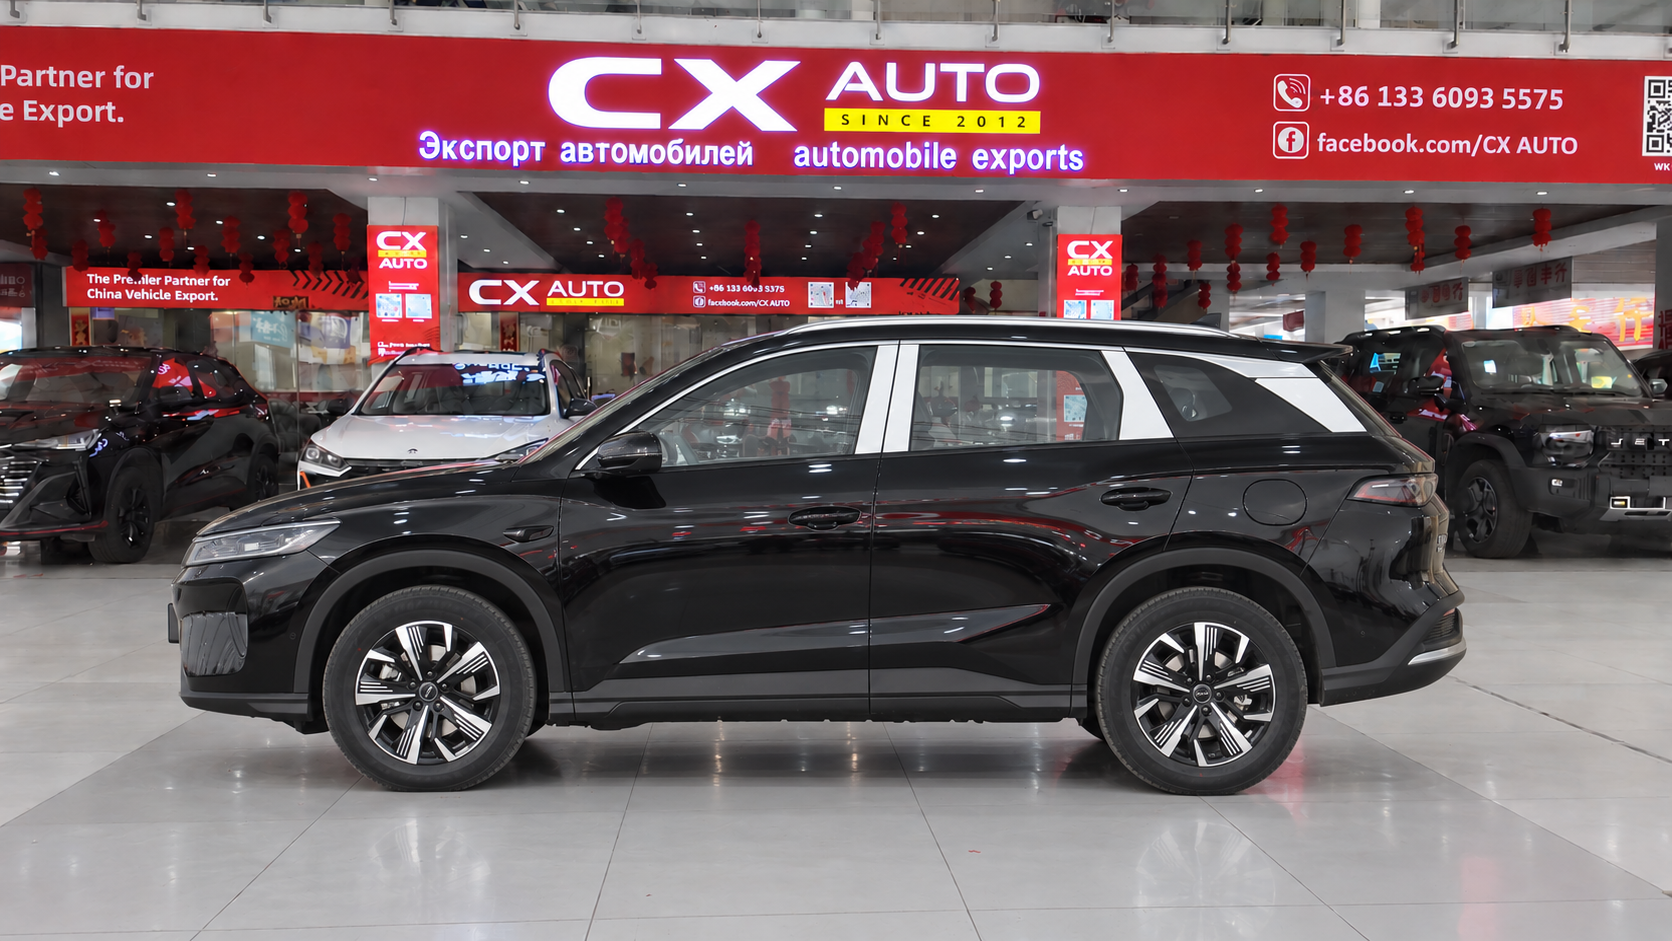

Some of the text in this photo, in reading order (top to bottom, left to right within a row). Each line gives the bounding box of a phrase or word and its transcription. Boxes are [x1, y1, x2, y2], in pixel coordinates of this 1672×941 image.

[1, 64, 154, 89] Partner for
[548, 56, 1040, 132] CX AUTO
[1320, 85, 1564, 110] +86 133 6093 5575
[23, 99, 124, 128] Export.
[841, 114, 1026, 128] SINCE 2012
[418, 130, 754, 168] Экспорт автомобилей
[1316, 132, 1579, 157] facebook.com/CX AUTO
[793, 141, 1084, 175] automobile exports
[376, 230, 427, 250] CX
[1066, 240, 1114, 259] CX
[379, 258, 428, 270] AUTO
[1067, 265, 1113, 277] AUTO
[86, 273, 110, 285] The
[164, 275, 211, 287] Partner
[212, 275, 231, 287] for
[86, 287, 219, 304] China Vehicle Export.
[468, 279, 625, 306] CX AUTO
[769, 299, 791, 308] AUTO
